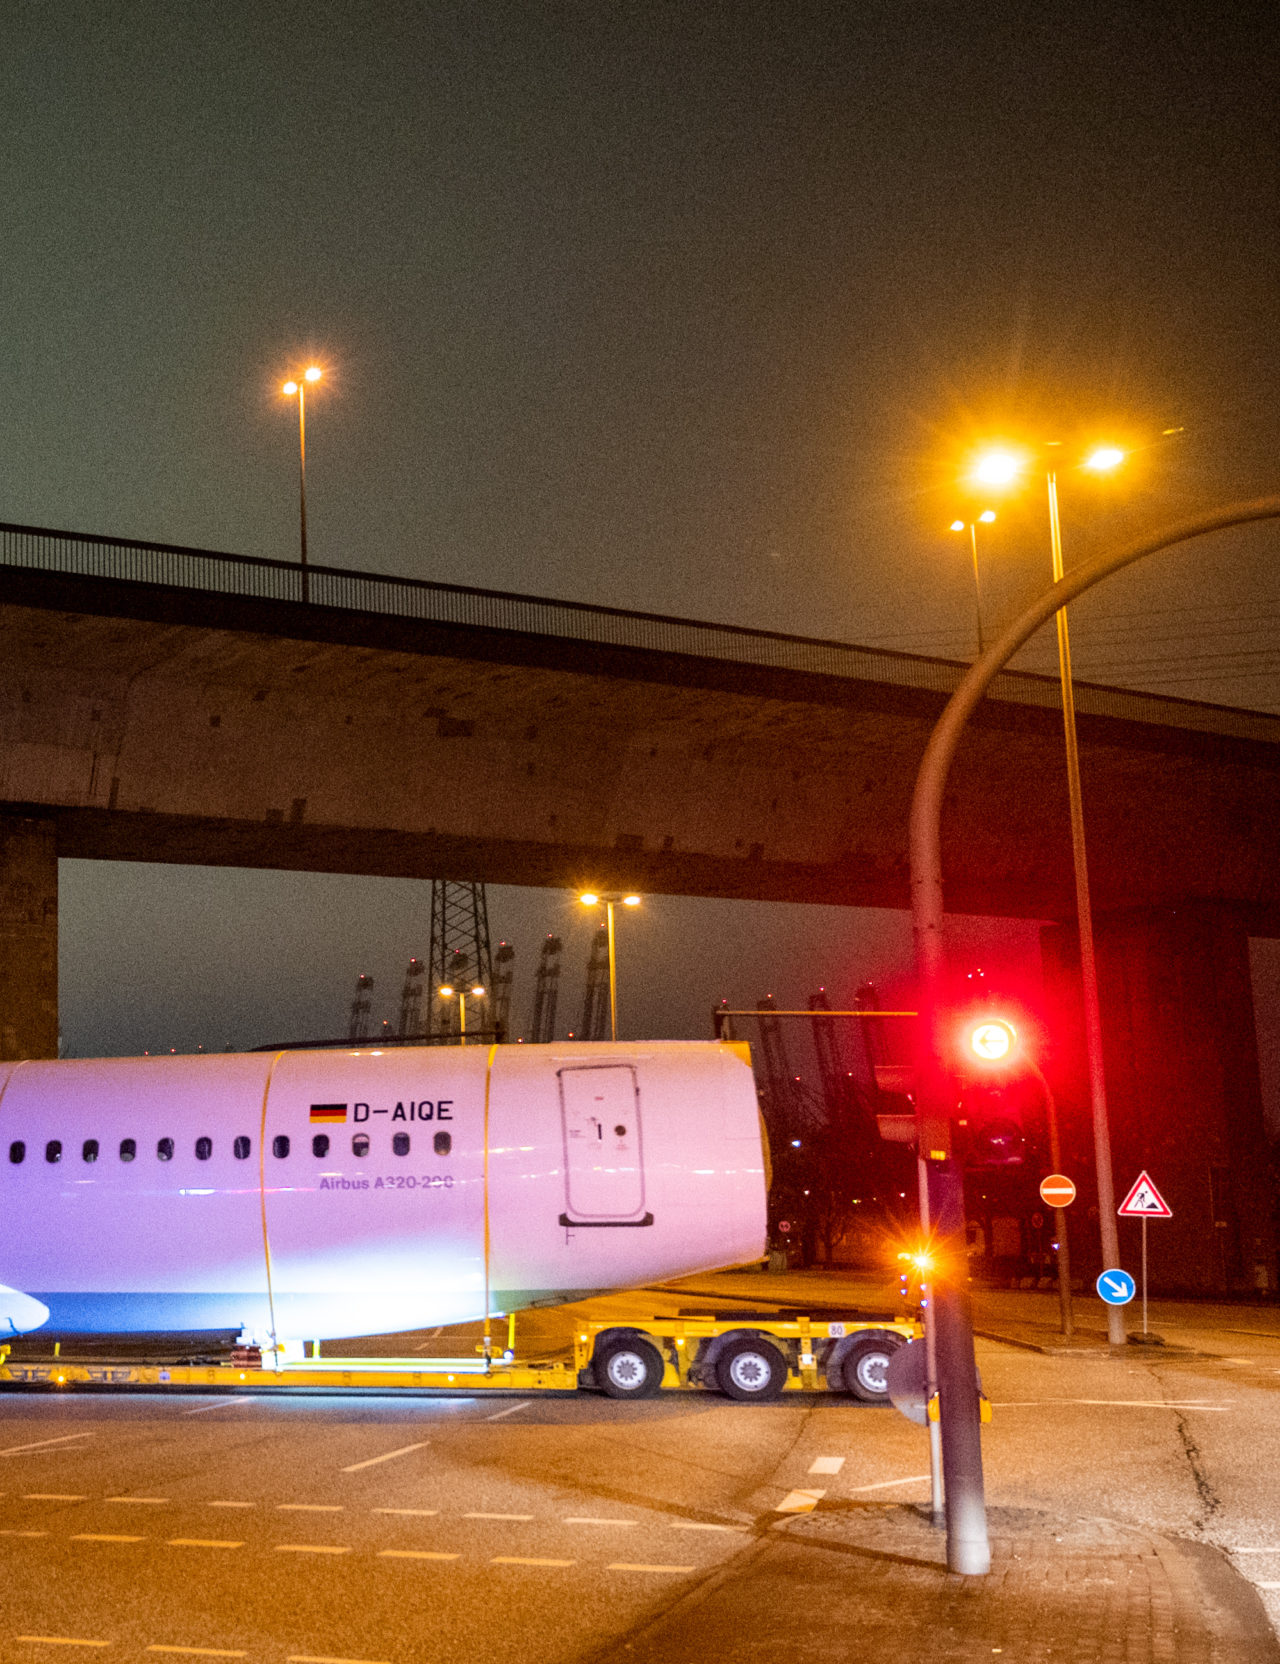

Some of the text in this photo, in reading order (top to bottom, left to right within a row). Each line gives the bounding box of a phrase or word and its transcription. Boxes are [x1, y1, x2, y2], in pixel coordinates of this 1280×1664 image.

[354, 1101, 454, 1122] D-AIQE
[320, 1175, 455, 1190] Airbus A320-200
